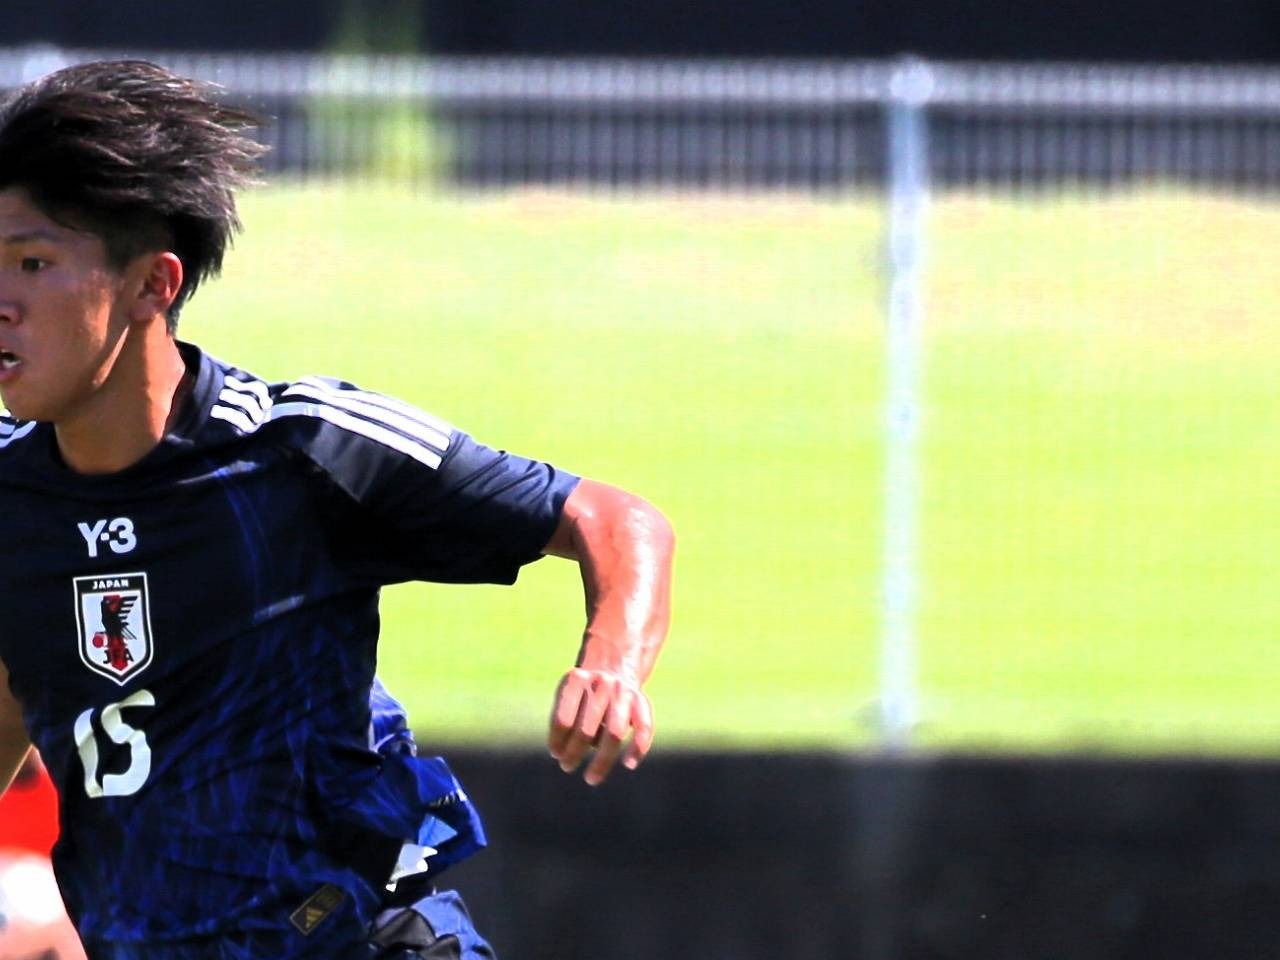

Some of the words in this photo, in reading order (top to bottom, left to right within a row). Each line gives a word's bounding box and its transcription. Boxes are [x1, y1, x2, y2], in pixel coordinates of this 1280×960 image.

[77, 517, 138, 557] Y-3
[92, 579, 129, 590] JAPAN
[74, 689, 156, 798] 15
